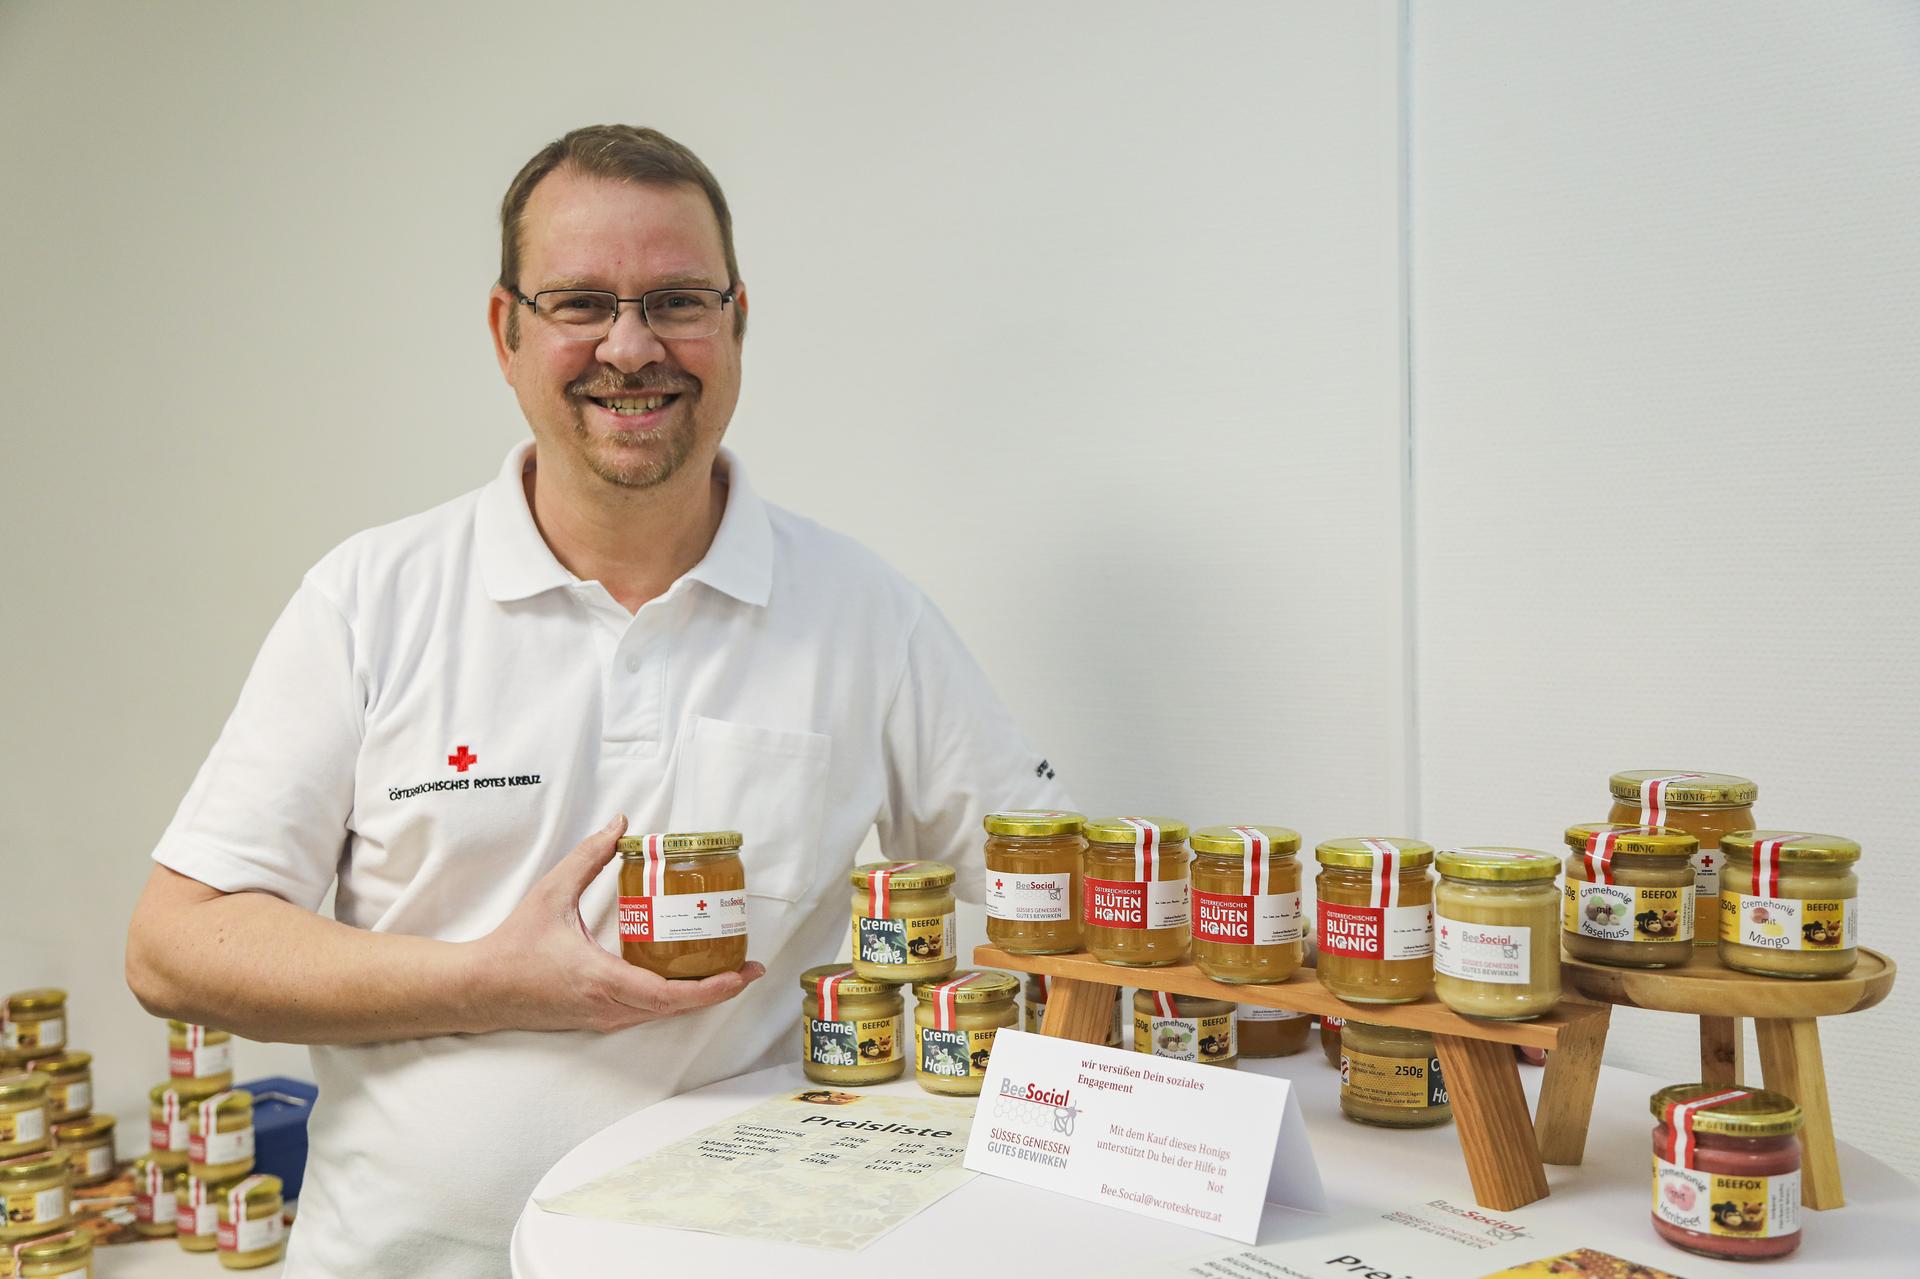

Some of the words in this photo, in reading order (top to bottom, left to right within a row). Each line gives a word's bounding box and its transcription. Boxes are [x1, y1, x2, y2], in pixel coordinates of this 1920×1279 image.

[474, 777, 506, 789] ROTES
[508, 775, 541, 787] KREUZ
[1627, 843, 1655, 853] HONIG
[1016, 880, 1056, 890] BeeSocial
[1094, 886, 1142, 895] ÖSTERREICHISCHER
[1094, 893, 1142, 909] BLÜTEN
[1580, 886, 1632, 905] Cremehonig
[1641, 889, 1678, 899] BEEFOX
[1094, 906, 1142, 923] HONIG
[1200, 905, 1248, 923] BLÜTEN
[1597, 905, 1612, 916] mit
[1741, 900, 1795, 917] Cremehonig
[1806, 902, 1840, 912] BEEFOX
[620, 909, 649, 922] BLÜTEN
[911, 918, 940, 928] BEEFOX
[1760, 918, 1776, 926] mit
[620, 922, 649, 936] HONIG
[860, 917, 902, 934] Creme
[1200, 920, 1248, 937] HONIG
[1326, 918, 1378, 937] BLÜTEN
[1582, 920, 1630, 939] Haselnuss
[1326, 933, 1378, 953] HONIG
[1462, 930, 1511, 945] BeeSocial
[1748, 930, 1790, 950] Mango
[811, 1019, 853, 1035] Creme
[862, 1020, 890, 1030] BEEFOX
[1152, 1019, 1196, 1034] Cremehonig
[1202, 1016, 1228, 1027] BEEFOX
[922, 1028, 965, 1045] Creme
[974, 1031, 997, 1041] BEEF
[1080, 1059, 1097, 1070] wir
[1099, 1062, 1141, 1079] versüßen
[1142, 1069, 1165, 1083] Dein
[1166, 1076, 1205, 1091] soziales
[1395, 1065, 1423, 1079] 250g
[1077, 1073, 1133, 1094] Engagement
[1000, 1077, 1070, 1107] BeeSocial
[800, 1115, 953, 1139] Preisliste
[990, 1127, 1022, 1145] SÜSSES
[1022, 1135, 1071, 1156] GENIESSEN
[1109, 1123, 1124, 1136] Mit
[1125, 1127, 1145, 1142] dem
[1146, 1131, 1169, 1146] Kauf
[1168, 1137, 1197, 1152] dieses
[1198, 1143, 1231, 1161] Honigs
[987, 1141, 1017, 1158] GUTES
[1017, 1148, 1068, 1169] BEWIRKEN
[1096, 1140, 1146, 1159] unterstützt
[1146, 1149, 1160, 1161] Du
[1161, 1152, 1175, 1165] bei
[1176, 1156, 1193, 1169] der
[1194, 1159, 1217, 1175] Hilfe
[1217, 1166, 1228, 1177] in
[1207, 1180, 1224, 1194] Not
[1717, 1178, 1761, 1190] BEEFOX
[1100, 1183, 1223, 1223] Bee.Social@w.roteskreuz.at
[1426, 1199, 1526, 1233] BeeSocial
